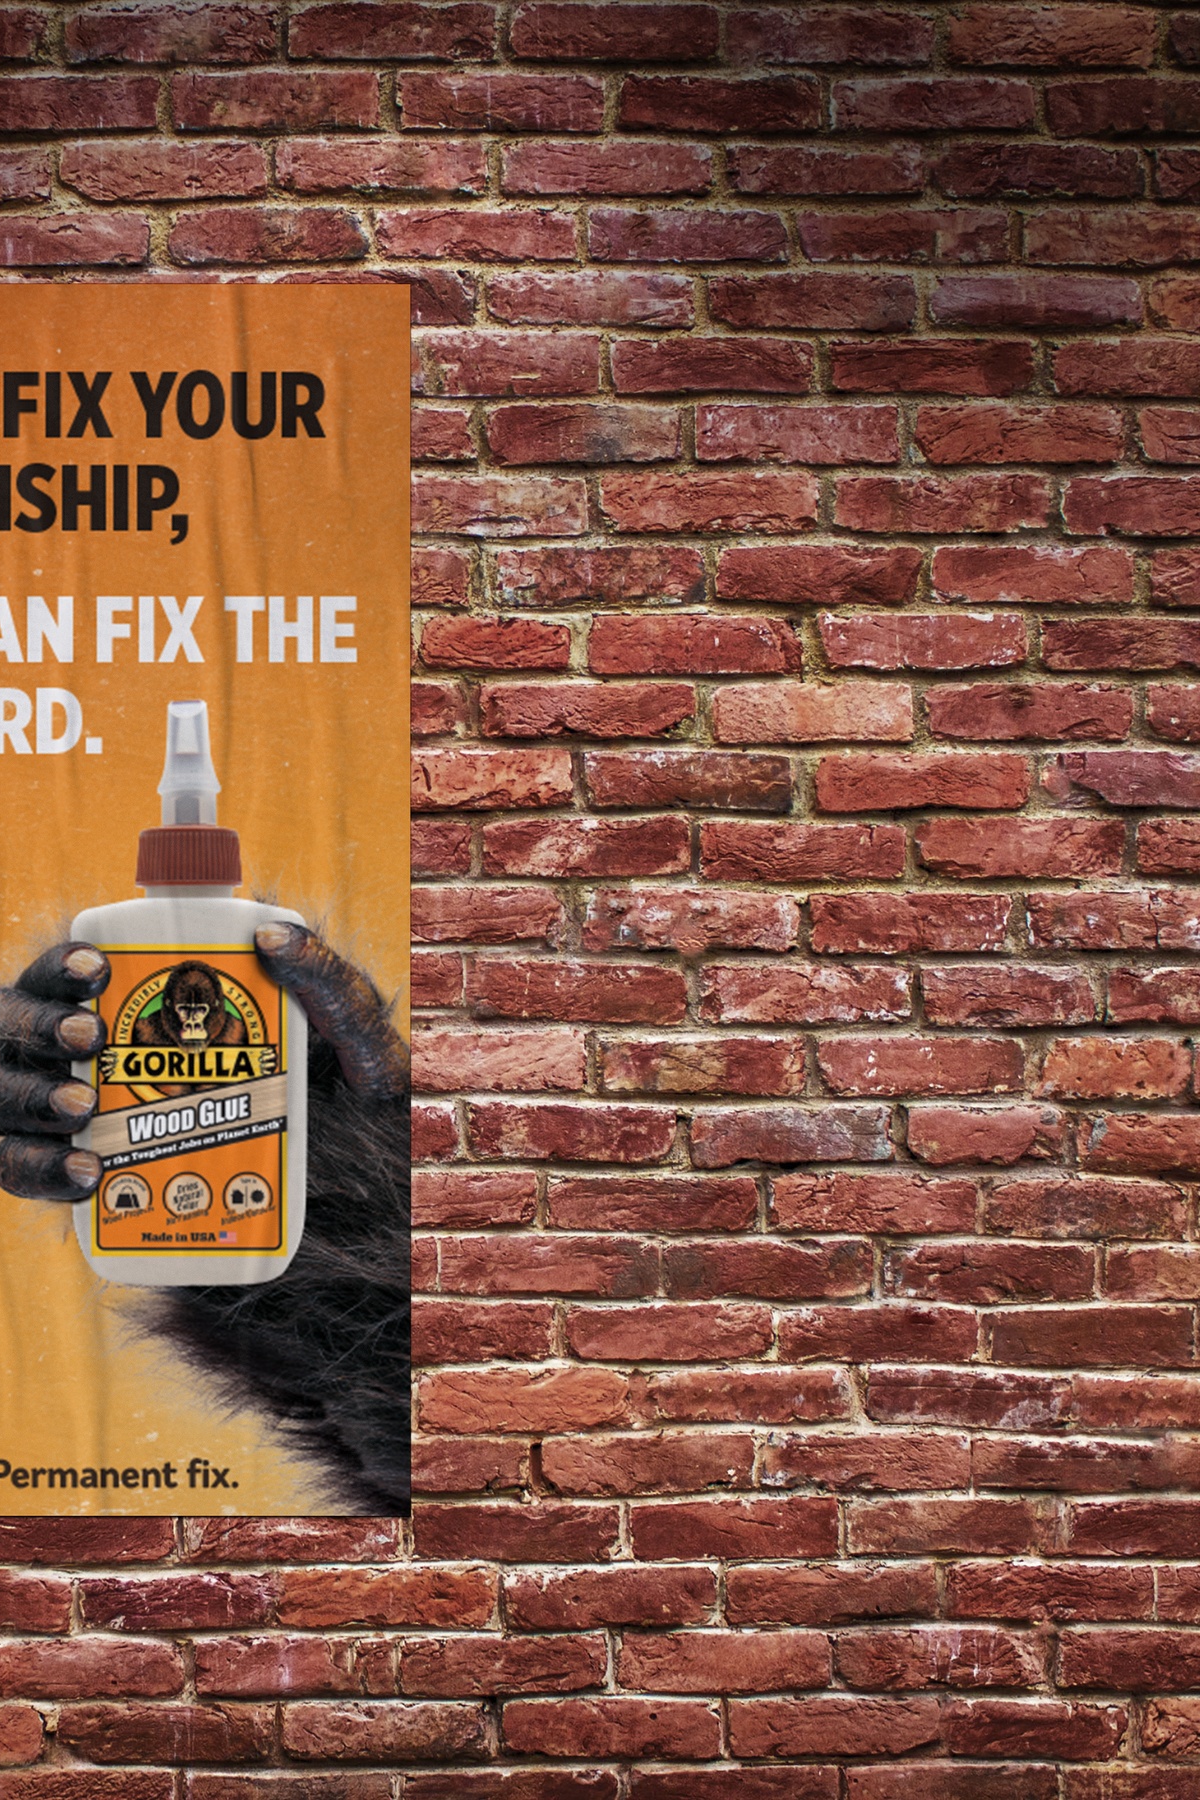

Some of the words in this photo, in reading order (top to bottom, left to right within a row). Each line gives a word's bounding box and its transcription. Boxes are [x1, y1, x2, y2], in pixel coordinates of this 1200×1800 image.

[3, 371, 113, 438] FIX
[130, 370, 326, 440] YOUR
[96, 595, 205, 663] FIX
[224, 595, 358, 663] THE
[118, 980, 161, 1041] INCREDIBLY
[226, 986, 261, 1040] STRONG
[123, 1051, 255, 1077] GORILLA
[113, 1155, 130, 1165] the
[131, 1143, 177, 1160] Toughest
[178, 1137, 202, 1151] Jobs
[203, 1136, 216, 1145] on
[217, 1127, 250, 1142] Planet
[141, 1232, 174, 1242] Made
[175, 1232, 188, 1242] in
[190, 1232, 216, 1242] USA
[186, 1458, 239, 1488] fix.
